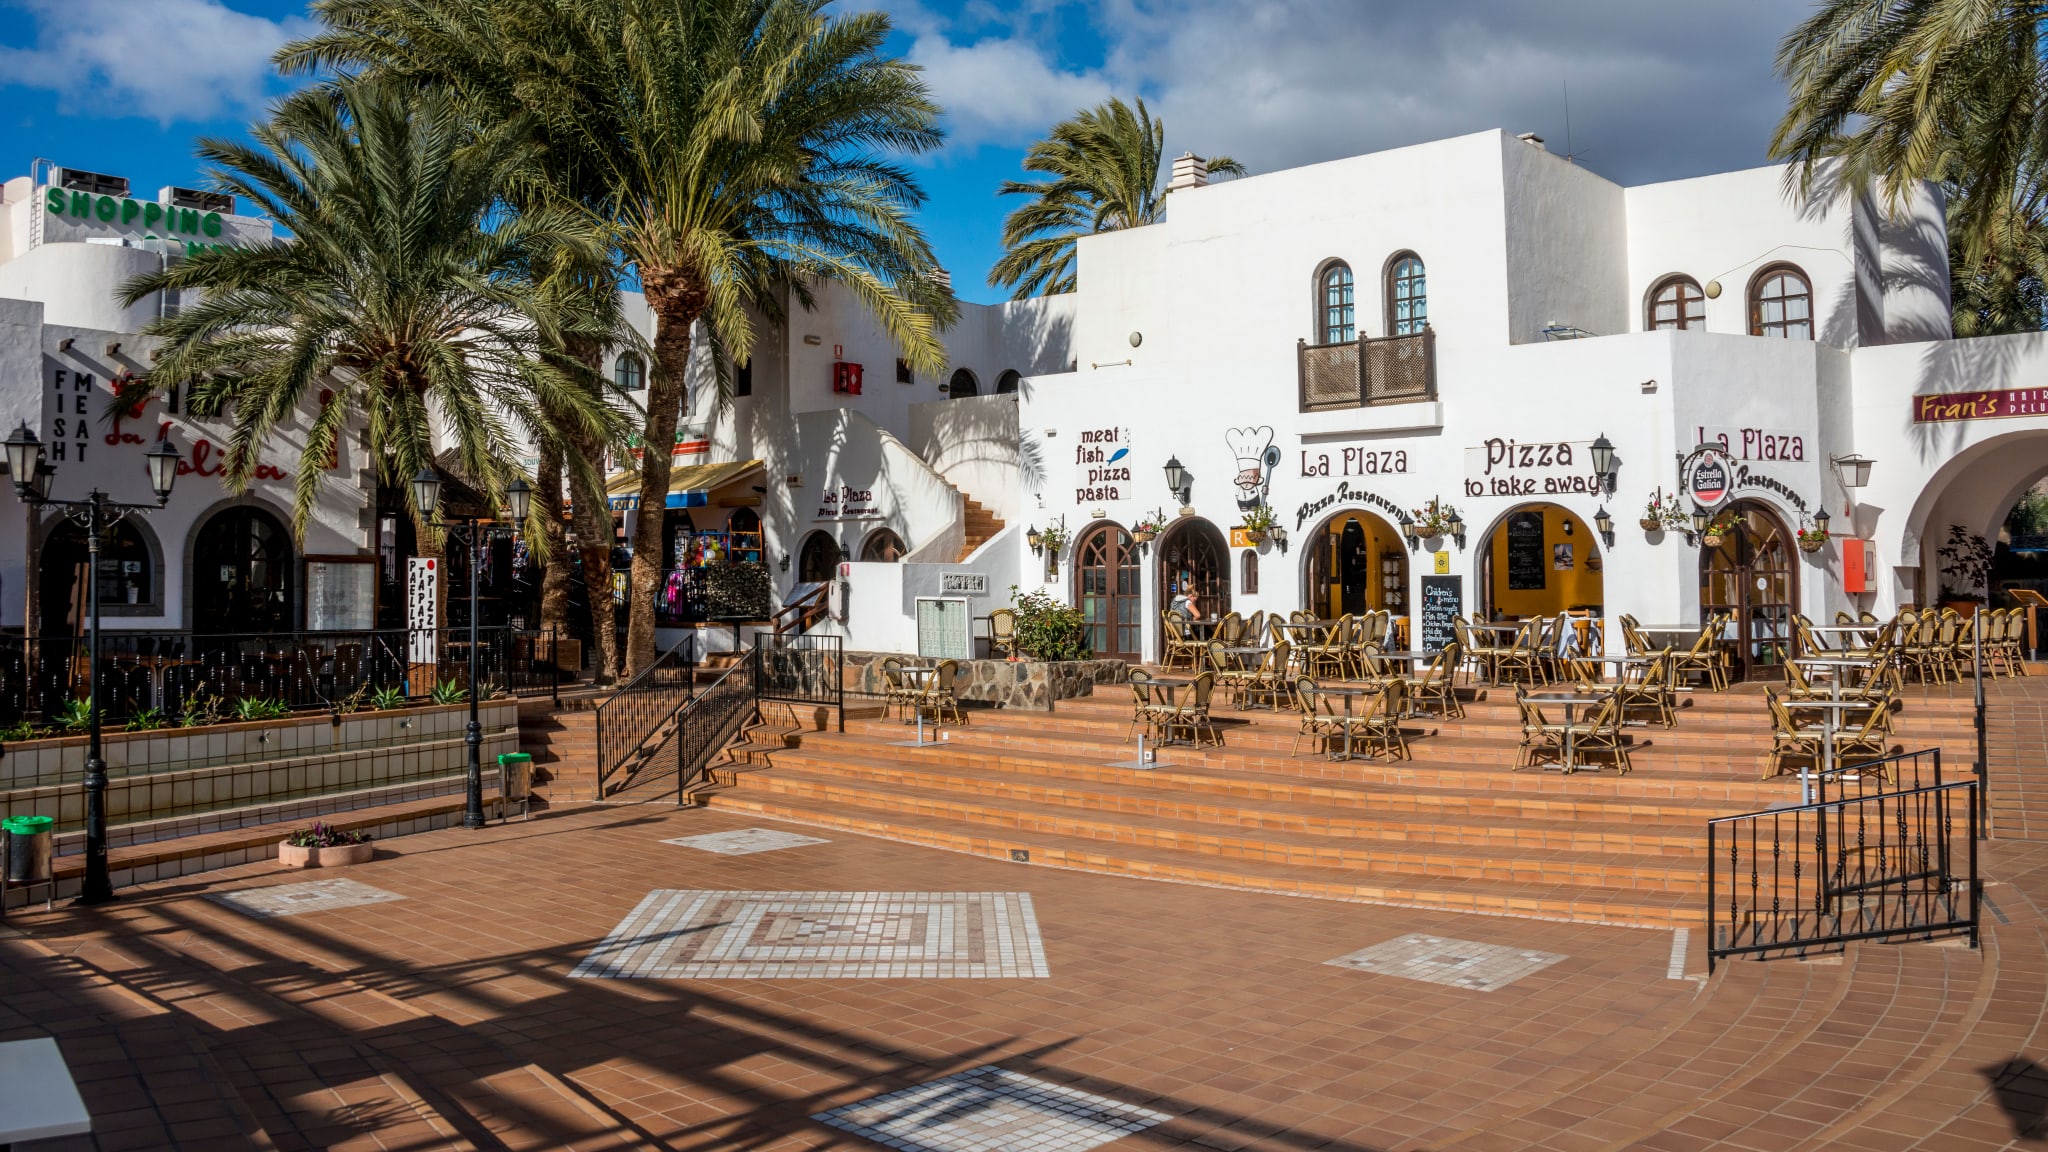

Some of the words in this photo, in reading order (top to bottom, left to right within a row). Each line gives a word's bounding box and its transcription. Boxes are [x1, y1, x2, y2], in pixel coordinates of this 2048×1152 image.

[47, 187, 222, 238] SHOPPING
[52, 370, 67, 461] FISH
[74, 373, 93, 462] MEAT
[1921, 394, 1998, 420] Fran's
[1081, 426, 1119, 443] meat
[1740, 428, 1804, 461] Plaza
[1076, 445, 1104, 465] fish
[1301, 450, 1329, 477] La
[1341, 446, 1407, 476] Plaza
[1484, 437, 1573, 475] Pizza
[1088, 465, 1131, 485] pizza
[1464, 478, 1484, 497] to
[1490, 475, 1536, 496] take
[1544, 475, 1602, 497] away
[1696, 469, 1722, 480] Estrella
[1697, 479, 1721, 490] Galicia
[1736, 464, 1807, 512] Restaurant
[823, 490, 838, 503] La
[841, 485, 872, 503] Plaza
[1076, 484, 1119, 505] pasta
[1296, 494, 1335, 532] Pizza
[1337, 481, 1404, 521] Restauran
[409, 561, 418, 645] PAELLAS
[417, 567, 425, 630] TAPAS
[426, 575, 435, 638] PIZZA
